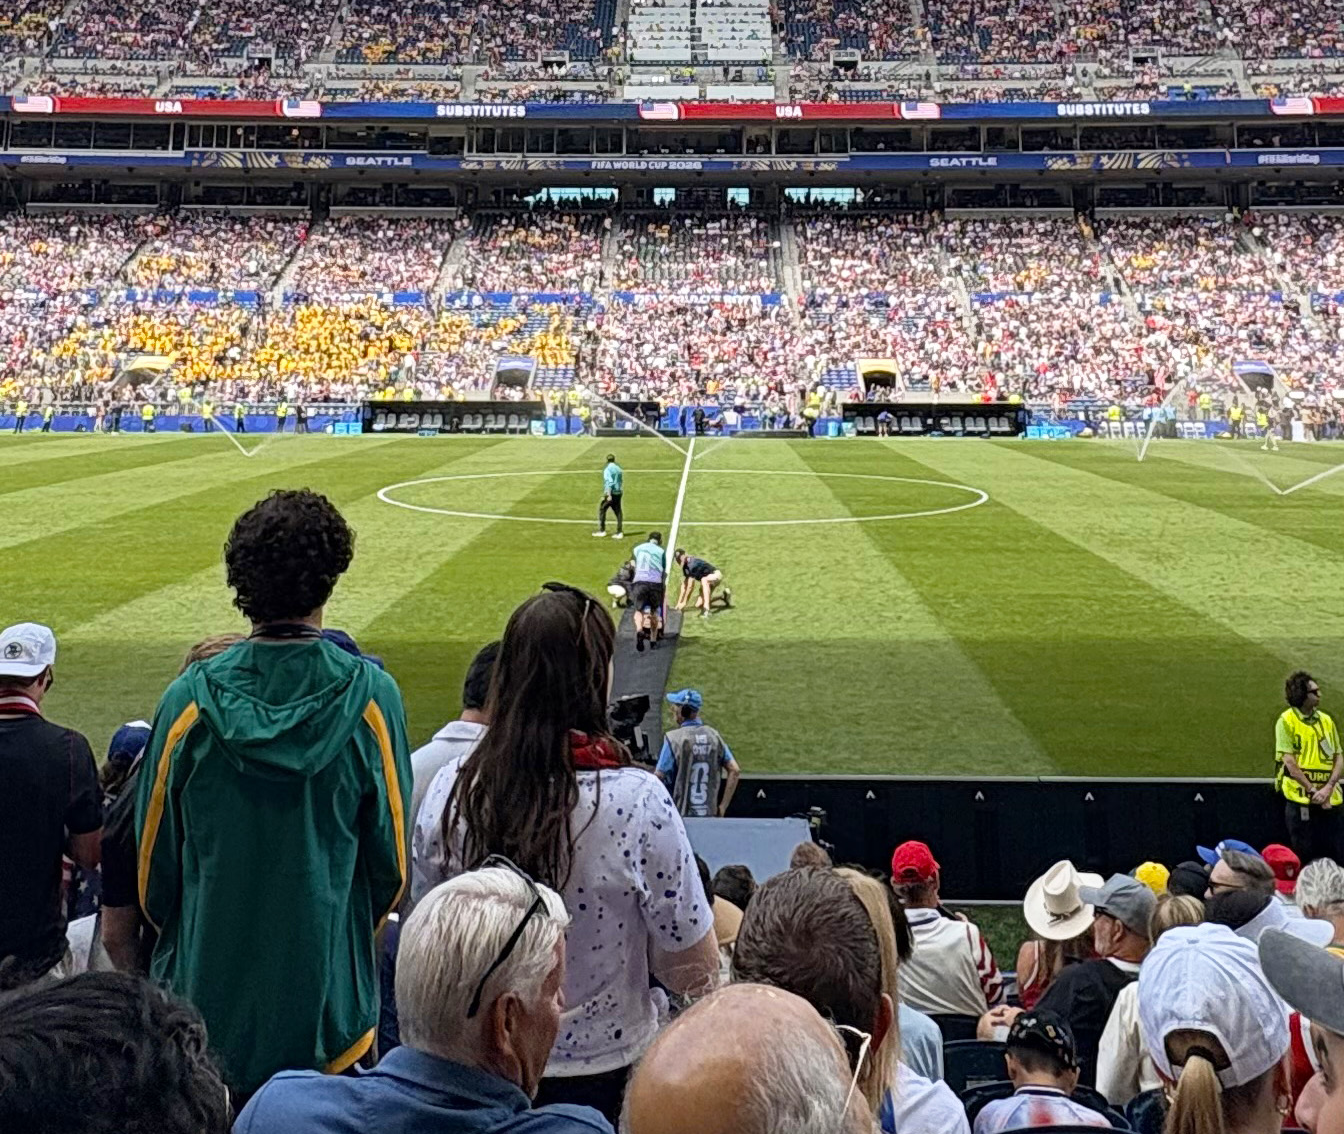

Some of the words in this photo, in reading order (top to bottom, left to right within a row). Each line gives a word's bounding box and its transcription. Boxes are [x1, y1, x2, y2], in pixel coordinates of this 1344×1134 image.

[155, 101, 182, 113] USA
[436, 105, 526, 116] SUBSTITUTES
[776, 106, 802, 117] USA
[1057, 103, 1150, 116] SUBSTITUTES
[346, 157, 412, 166] SEATTLE
[591, 161, 612, 169] FIFA
[612, 161, 647, 169] WORLD
[648, 161, 668, 169] CUP
[668, 161, 702, 169] 2026
[929, 157, 997, 167] SEATTLE
